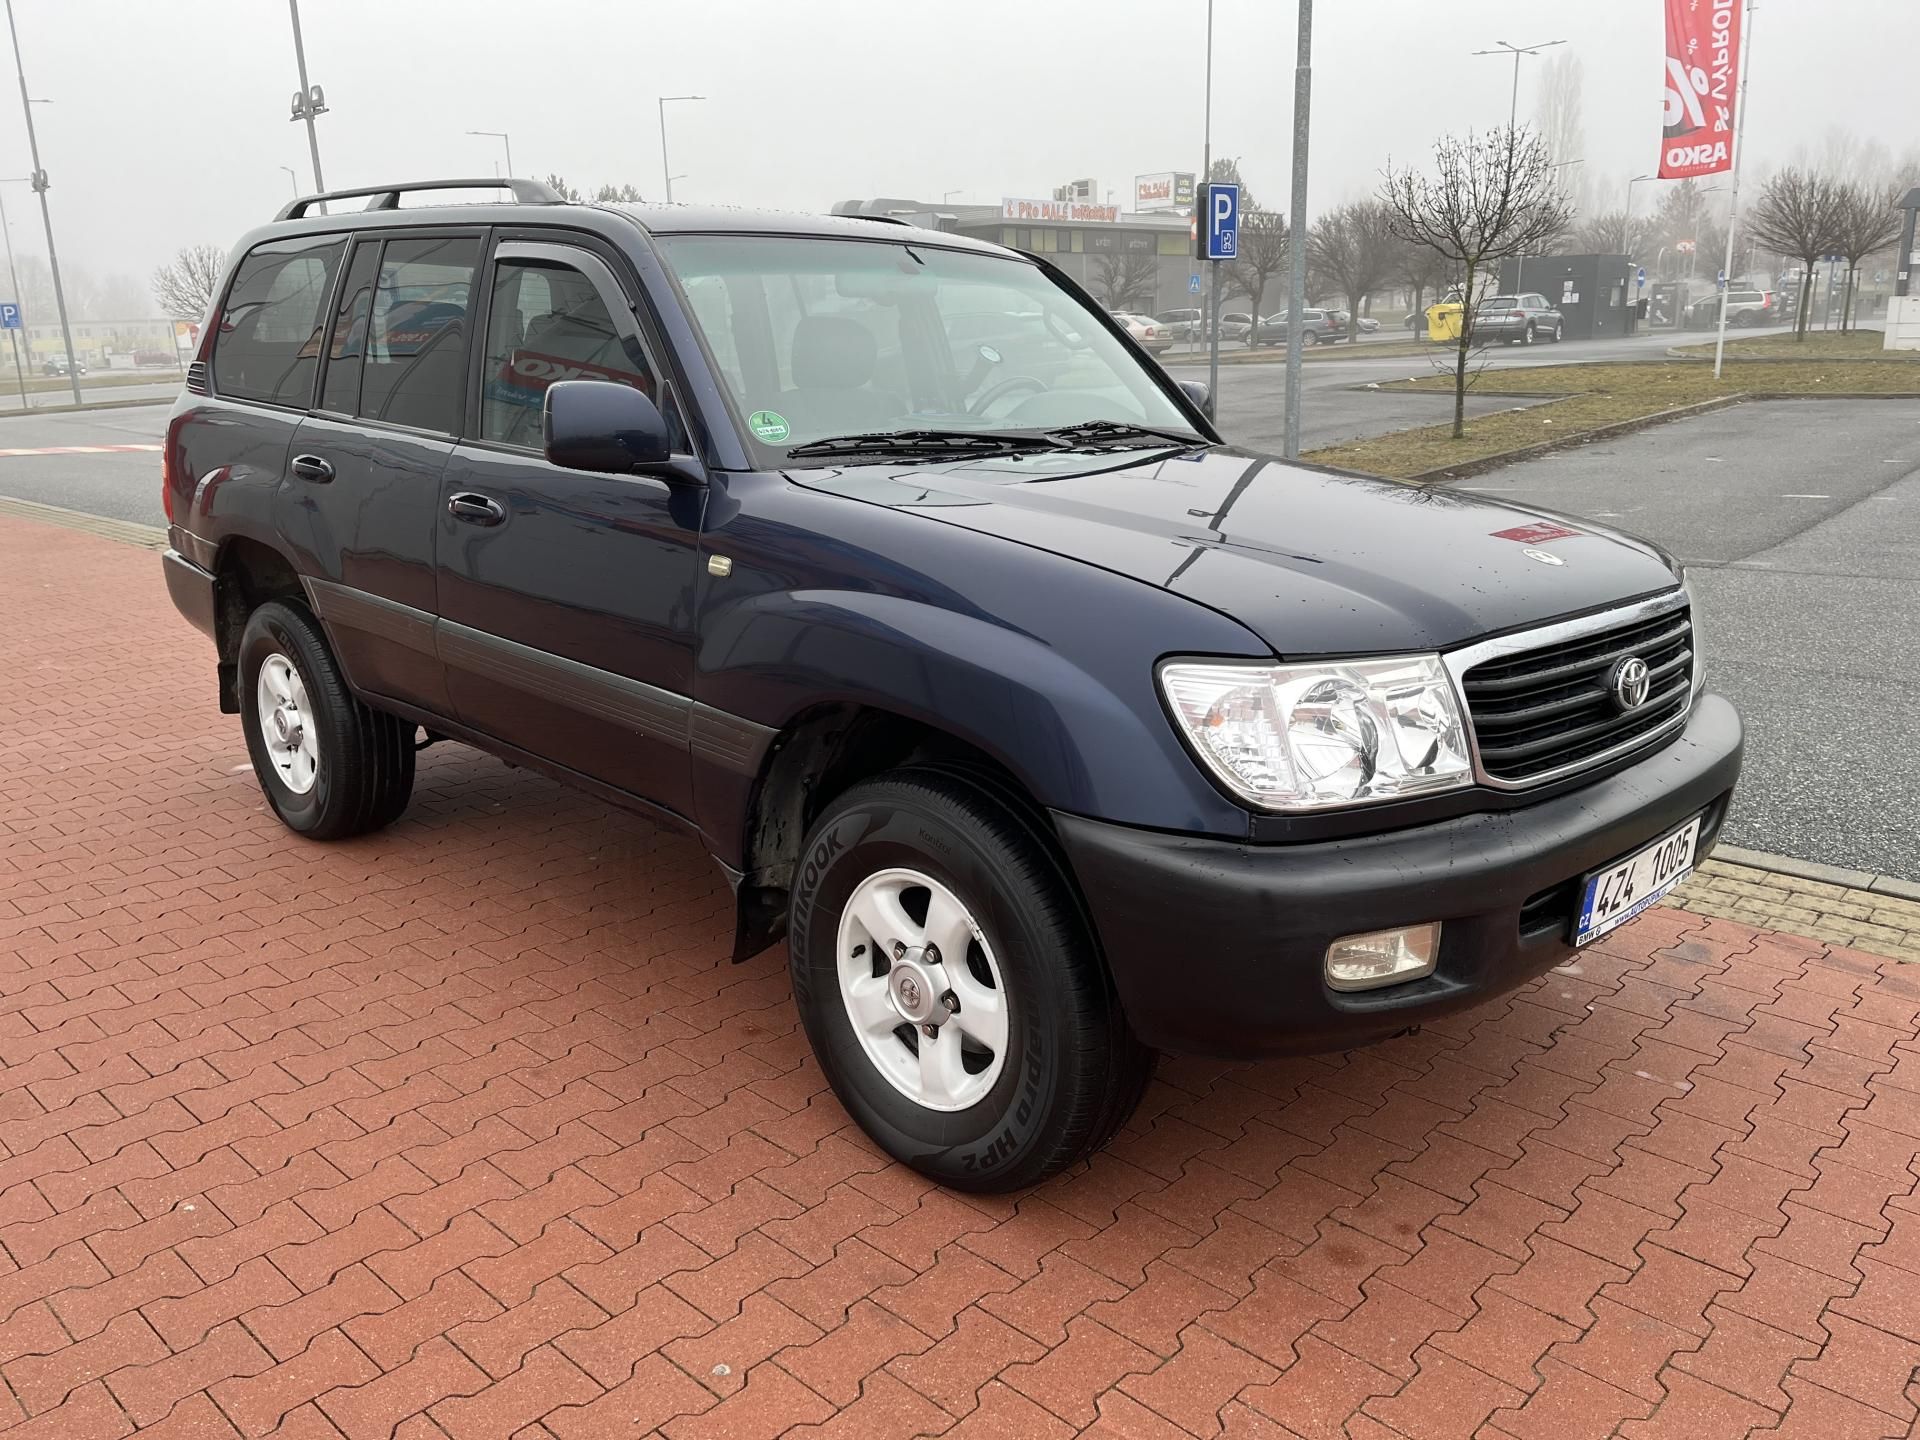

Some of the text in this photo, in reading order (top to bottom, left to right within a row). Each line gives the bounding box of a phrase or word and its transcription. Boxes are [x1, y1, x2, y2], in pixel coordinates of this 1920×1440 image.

[1215, 193, 1232, 236] P
[3, 306, 16, 321] P
[1597, 825, 1692, 916] 4Z4 1005
[1578, 912, 1590, 929] CZ
